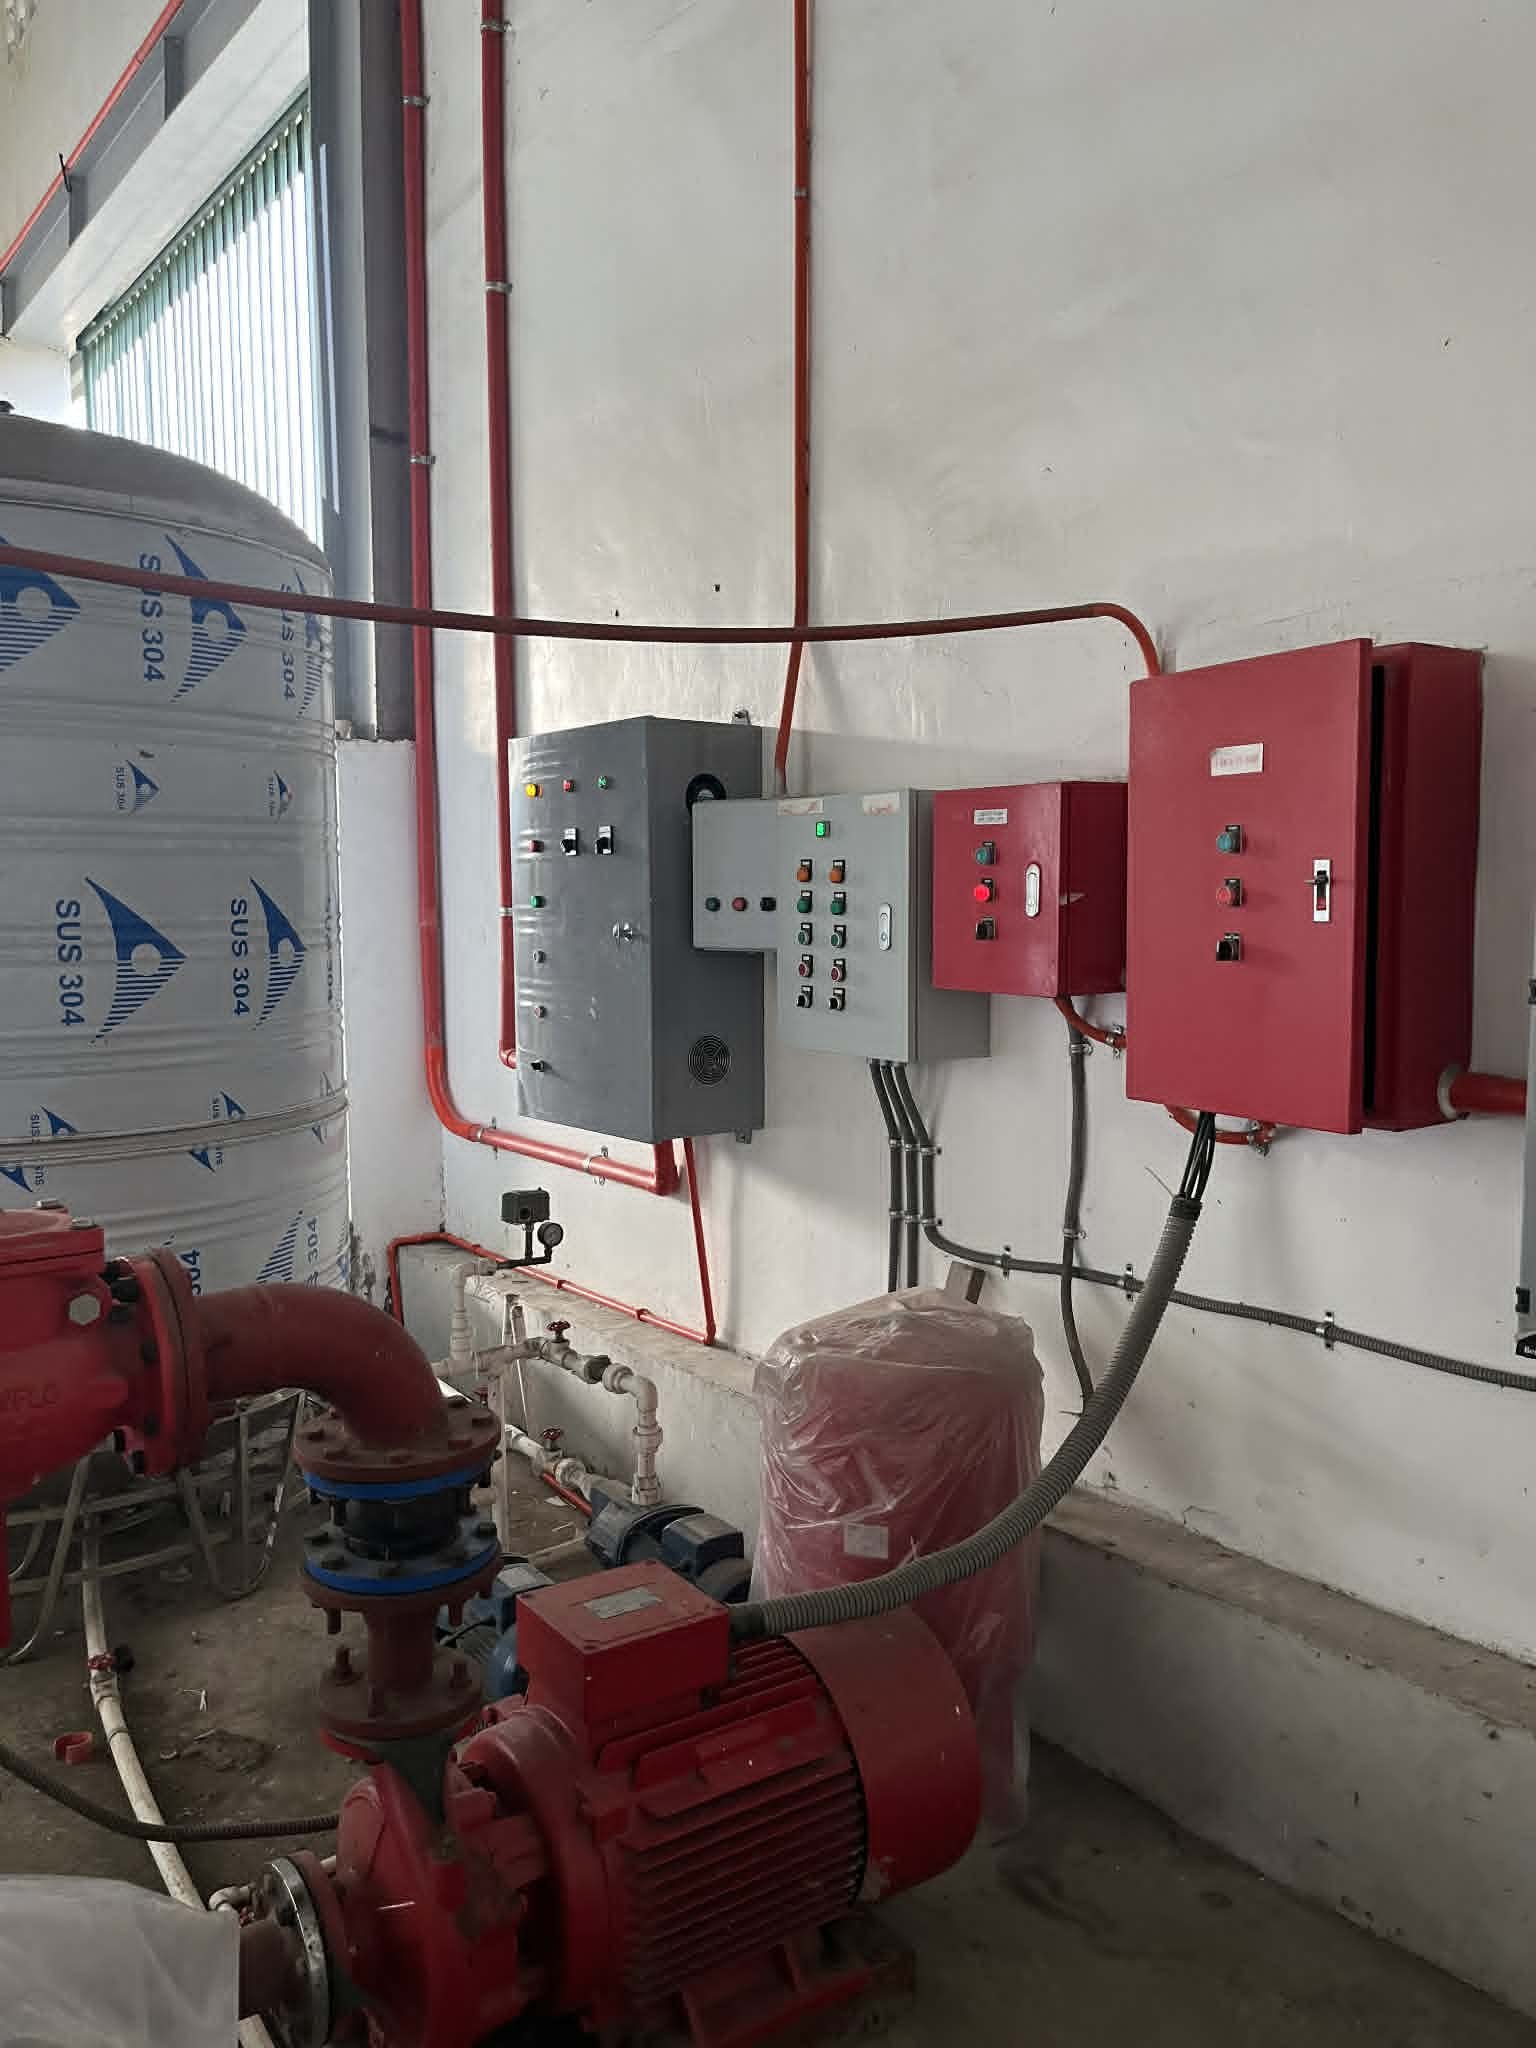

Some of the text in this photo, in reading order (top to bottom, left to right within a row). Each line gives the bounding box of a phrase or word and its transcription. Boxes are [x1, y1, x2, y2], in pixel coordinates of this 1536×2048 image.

[142, 628, 165, 682] 304
[282, 652, 296, 700] 304
[56, 899, 85, 1026] SUS 304
[231, 898, 251, 1017] SUS 304
[305, 1216, 320, 1264] 304
